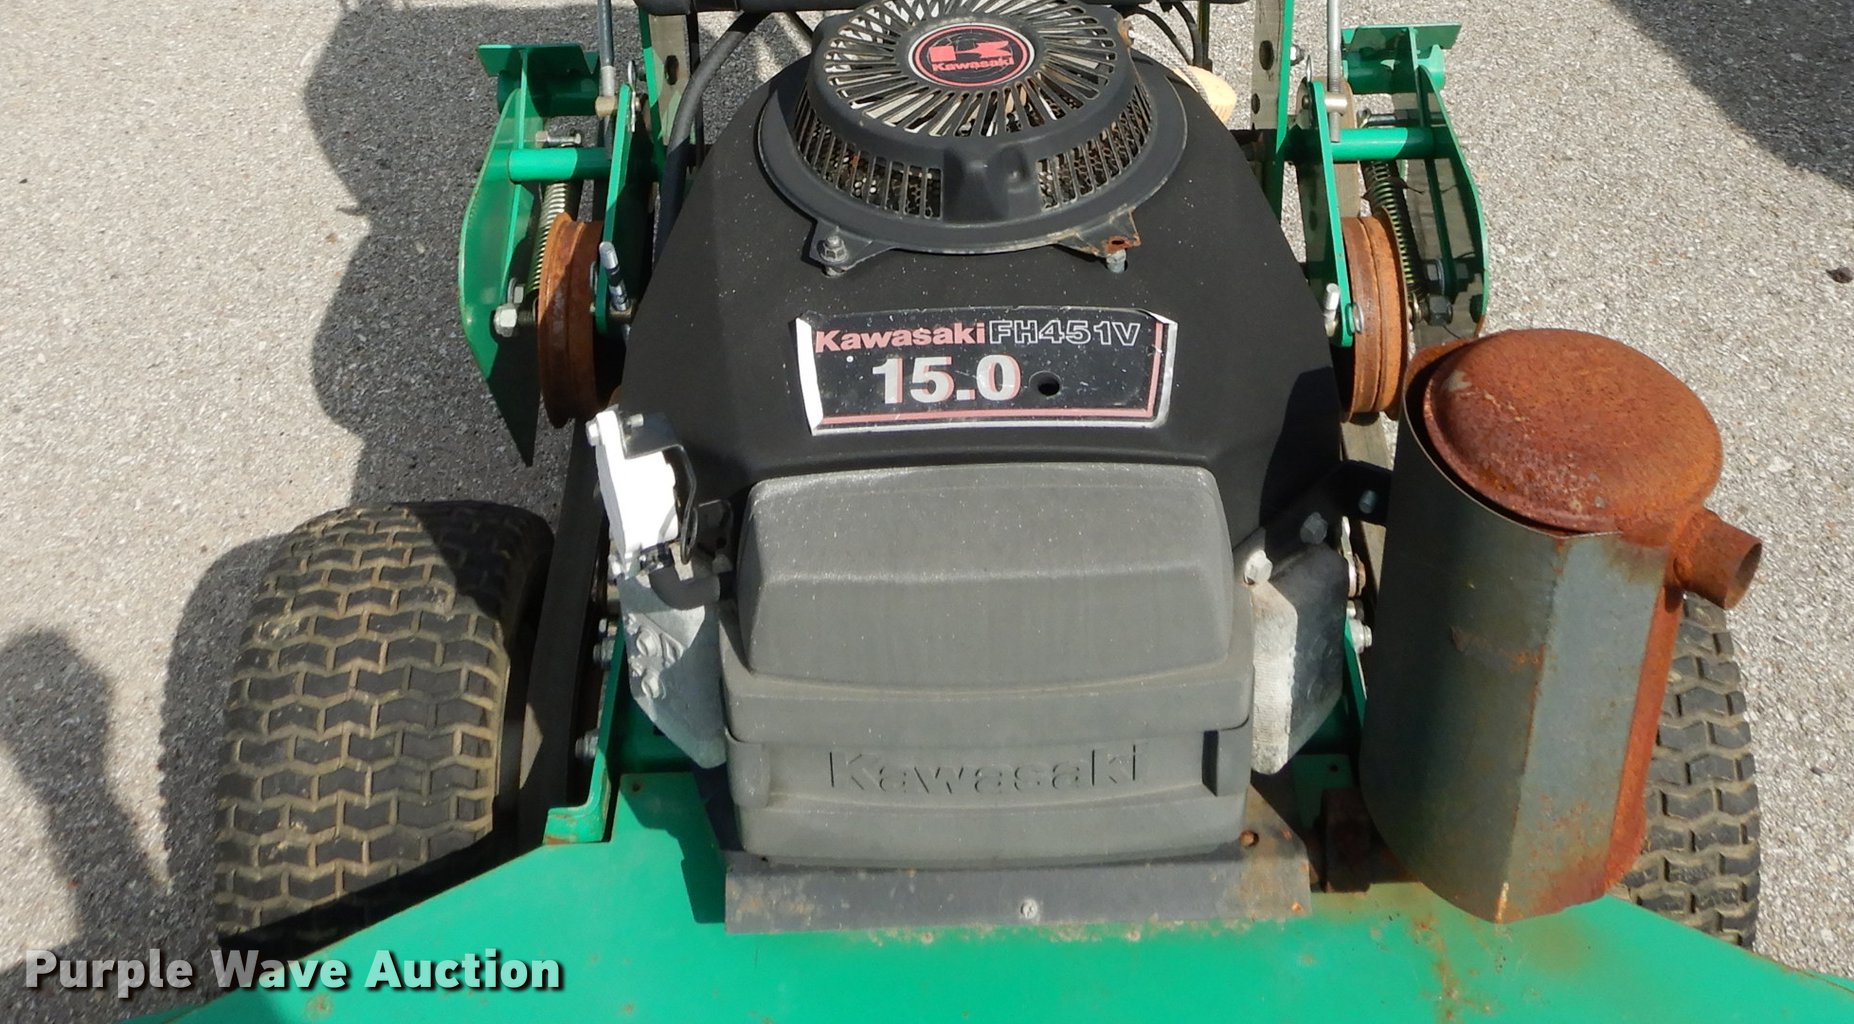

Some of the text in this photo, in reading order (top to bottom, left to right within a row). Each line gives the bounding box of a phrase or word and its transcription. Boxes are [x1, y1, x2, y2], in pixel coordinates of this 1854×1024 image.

[931, 55, 1015, 73] Kawasaki
[814, 319, 1142, 354] Kawasaki FH451V
[871, 354, 1022, 405] 15.0
[828, 744, 1142, 795] Kawasaki
